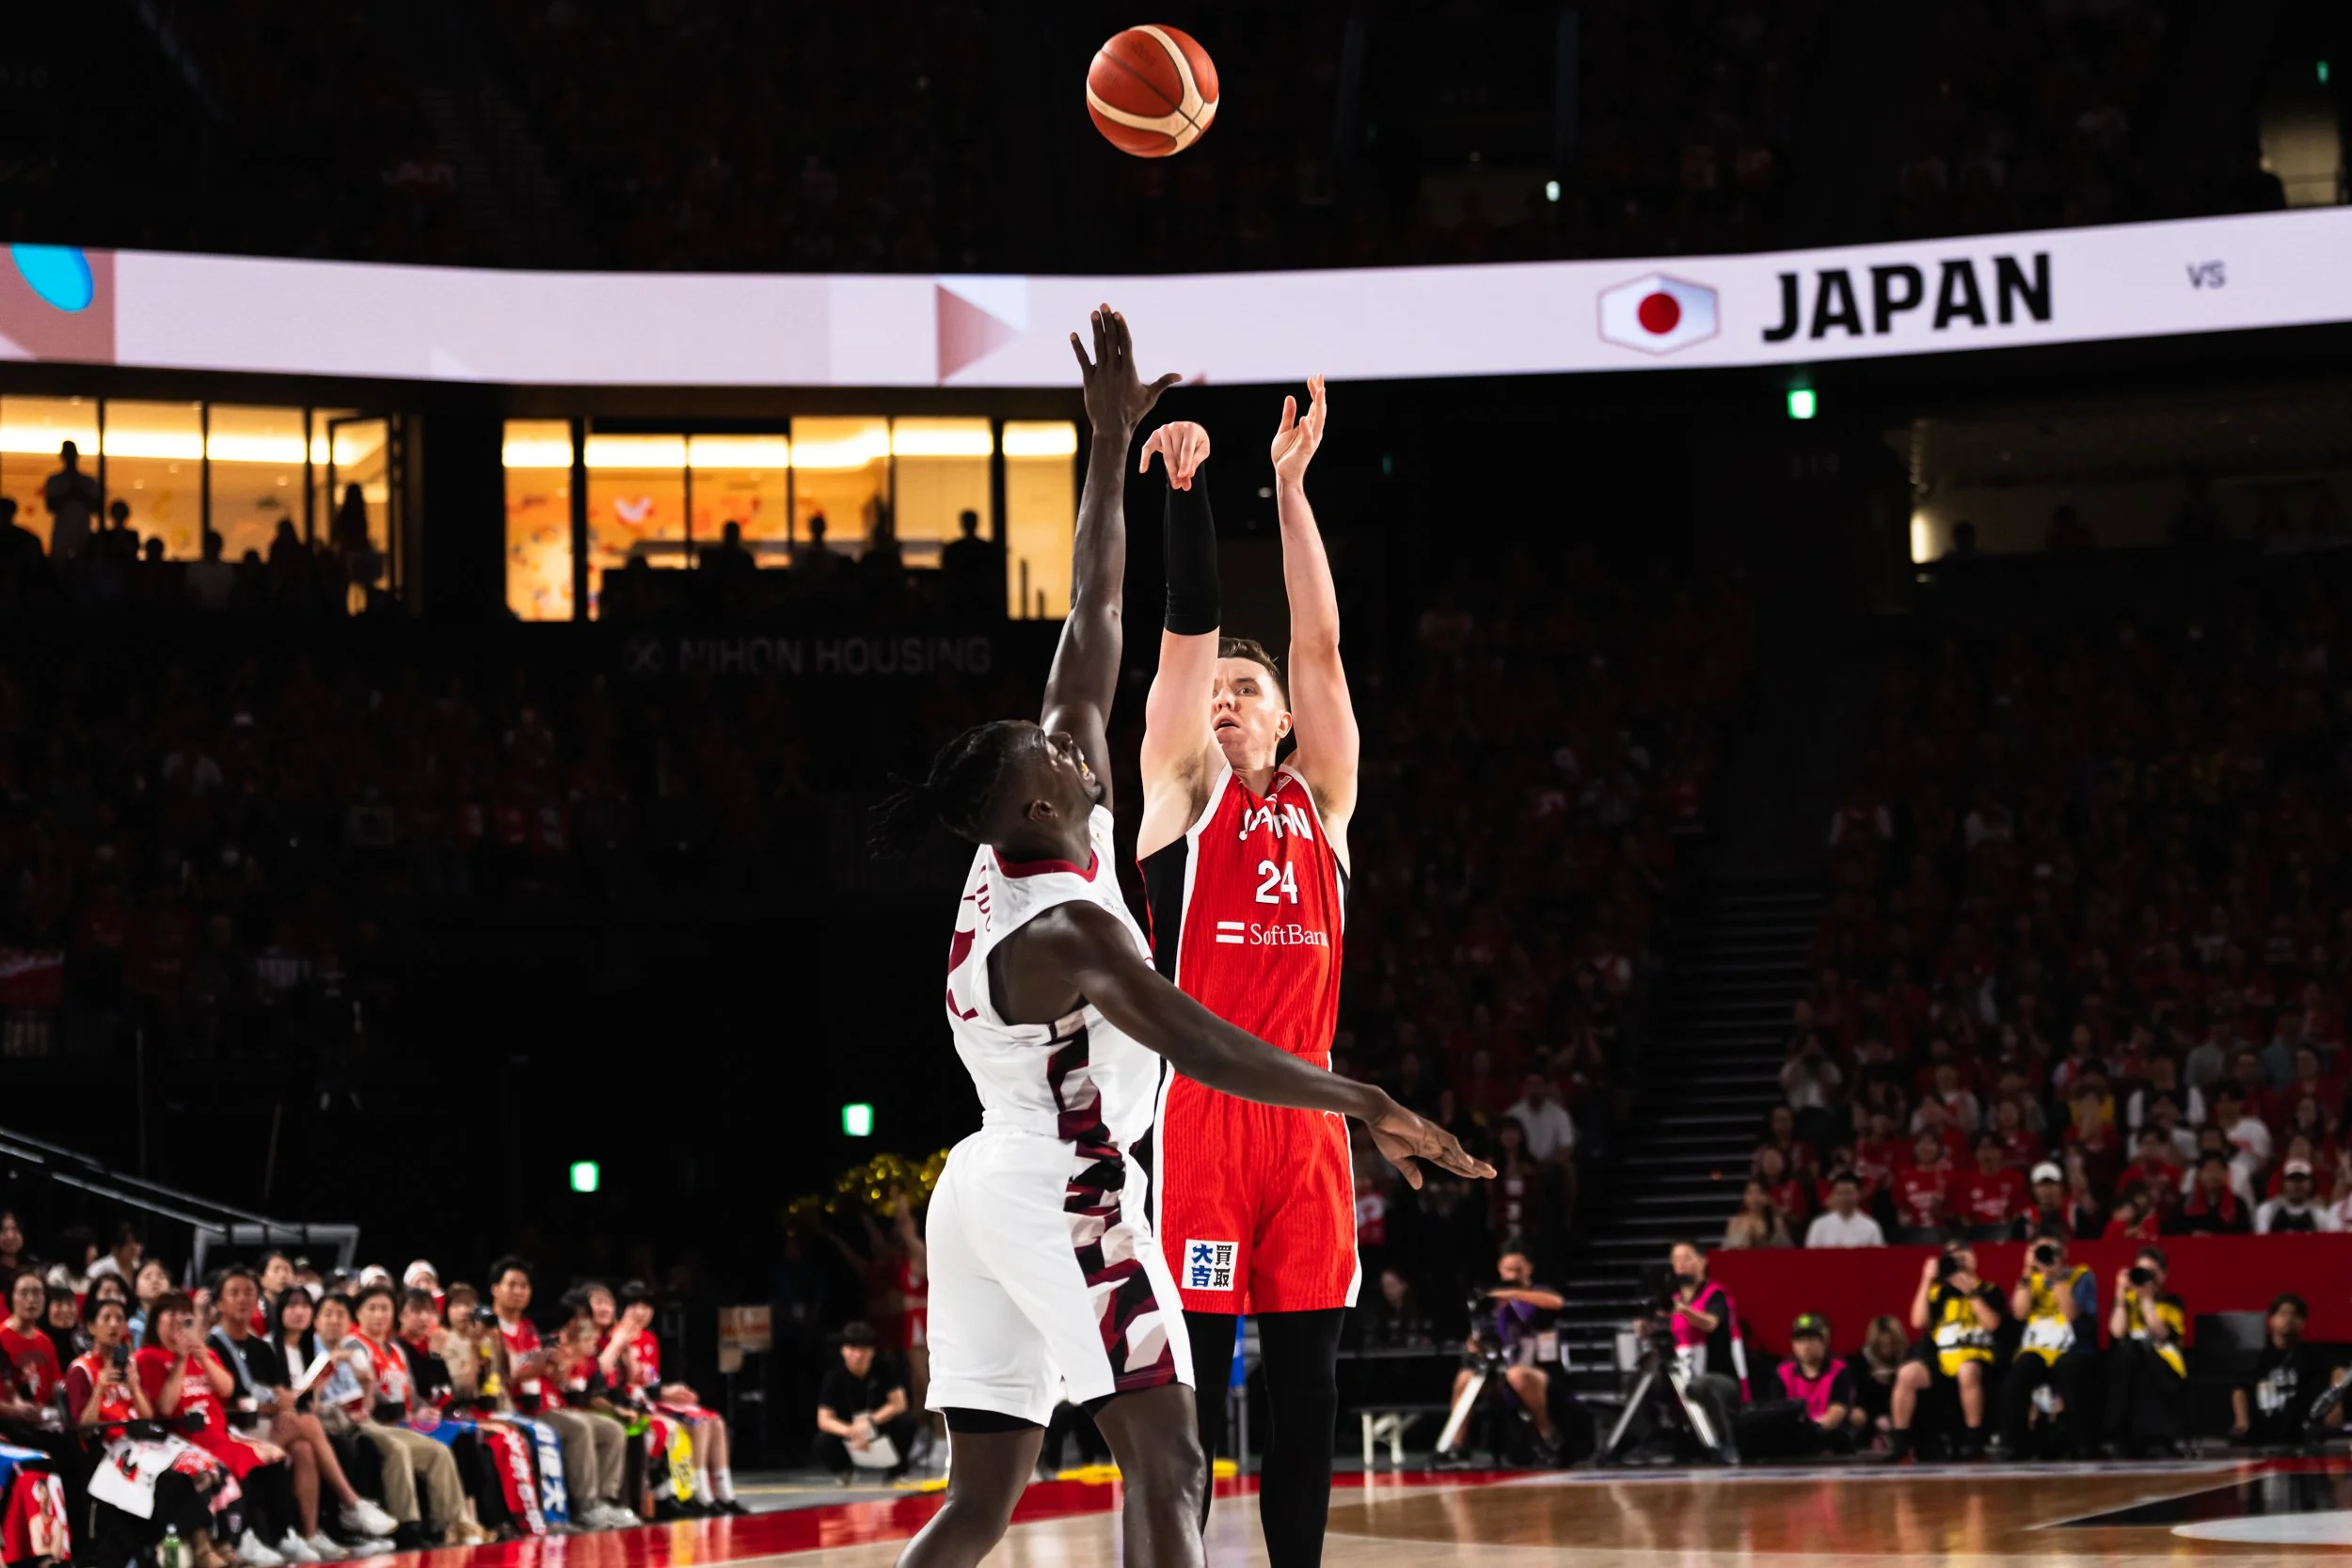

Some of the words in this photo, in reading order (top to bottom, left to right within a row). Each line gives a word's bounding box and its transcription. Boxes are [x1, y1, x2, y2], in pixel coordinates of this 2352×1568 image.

[1763, 252, 2052, 343] JAPAN
[678, 637, 803, 675] NIHON
[815, 635, 993, 674] HOUSING
[1255, 860, 1298, 905] 24
[1191, 1243, 1214, 1287] 大吉
[1214, 1244, 1232, 1287] 買取
